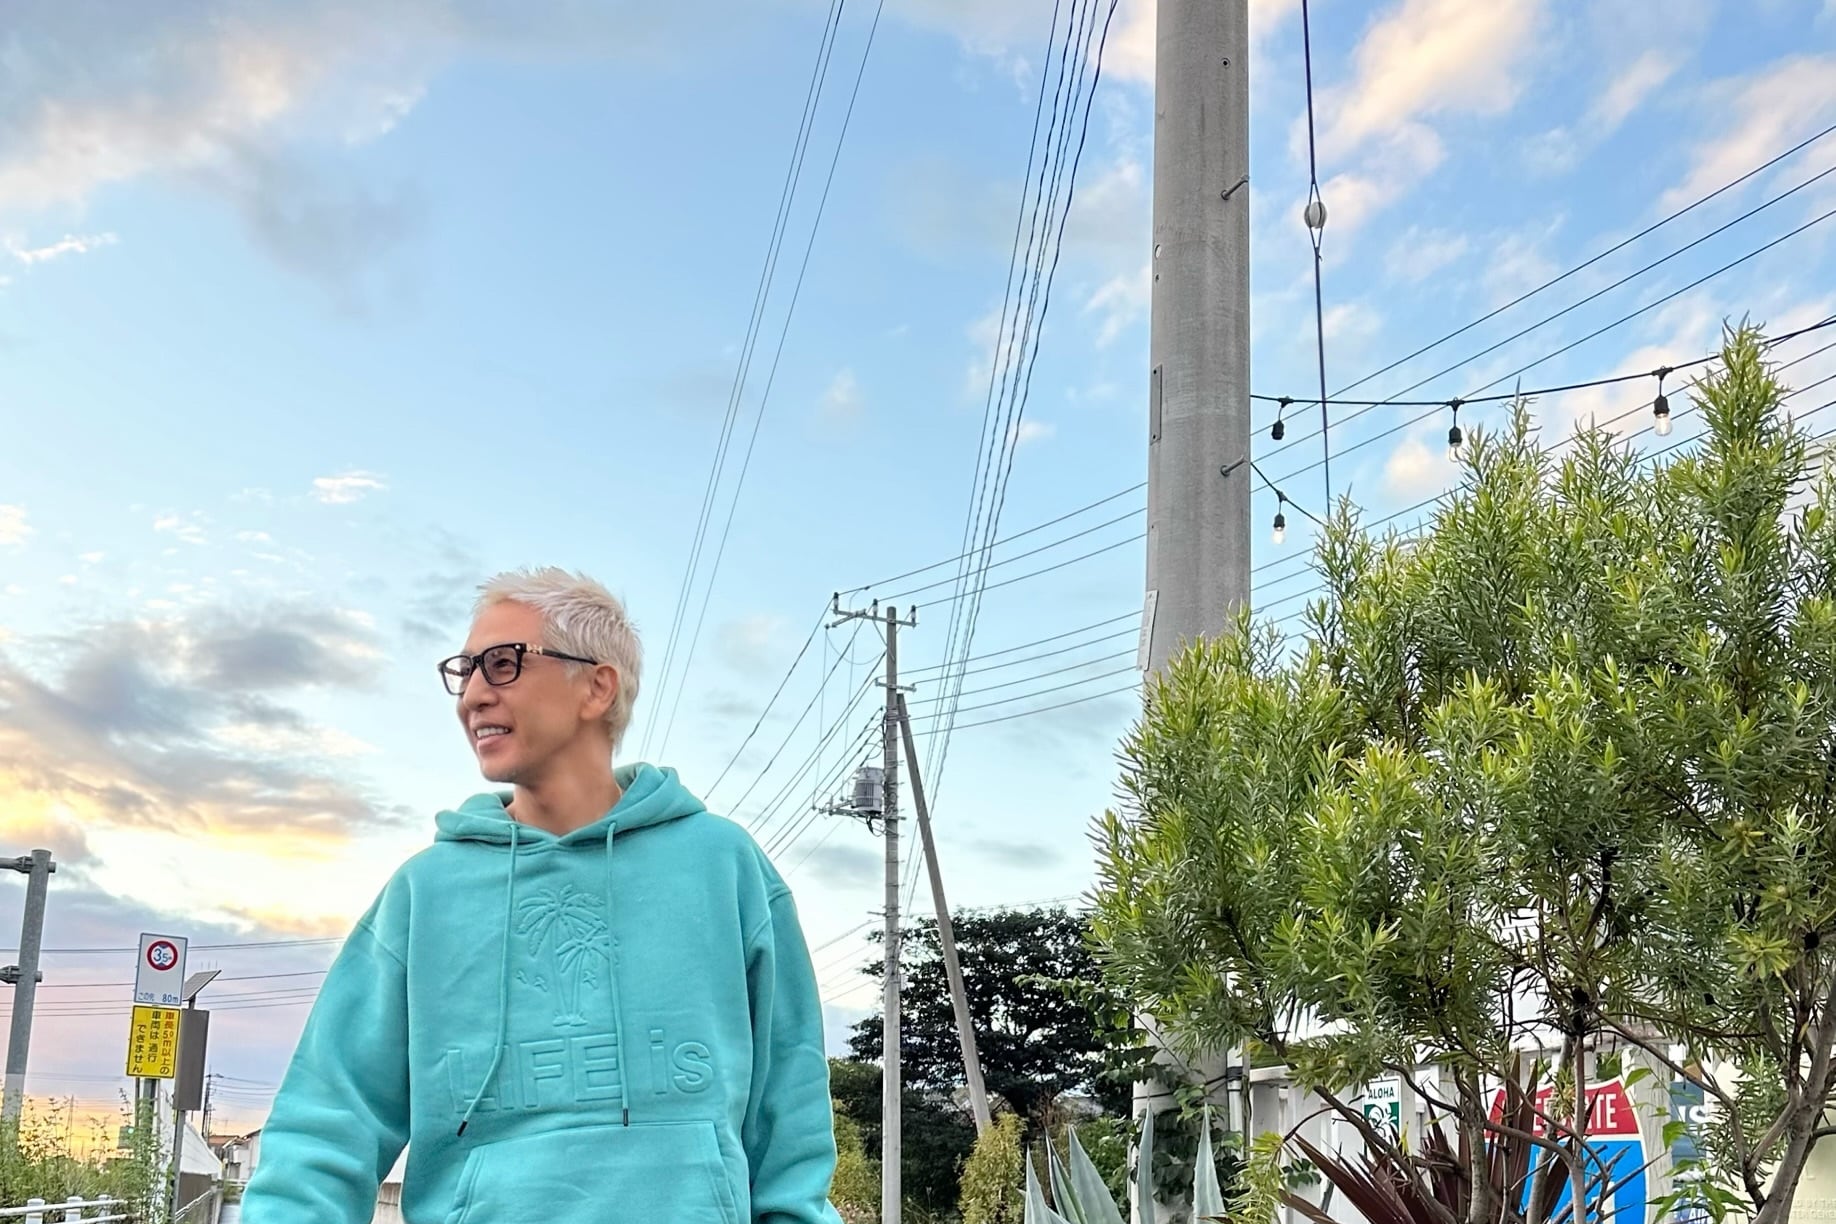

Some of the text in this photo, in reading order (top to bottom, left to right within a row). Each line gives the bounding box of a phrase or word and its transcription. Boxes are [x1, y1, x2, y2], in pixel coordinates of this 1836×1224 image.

[162, 993, 179, 1003] 80m
[132, 1024, 148, 1074] できません
[446, 1029, 714, 1113] LIFE is
[1368, 1086, 1395, 1100] ALOHA
